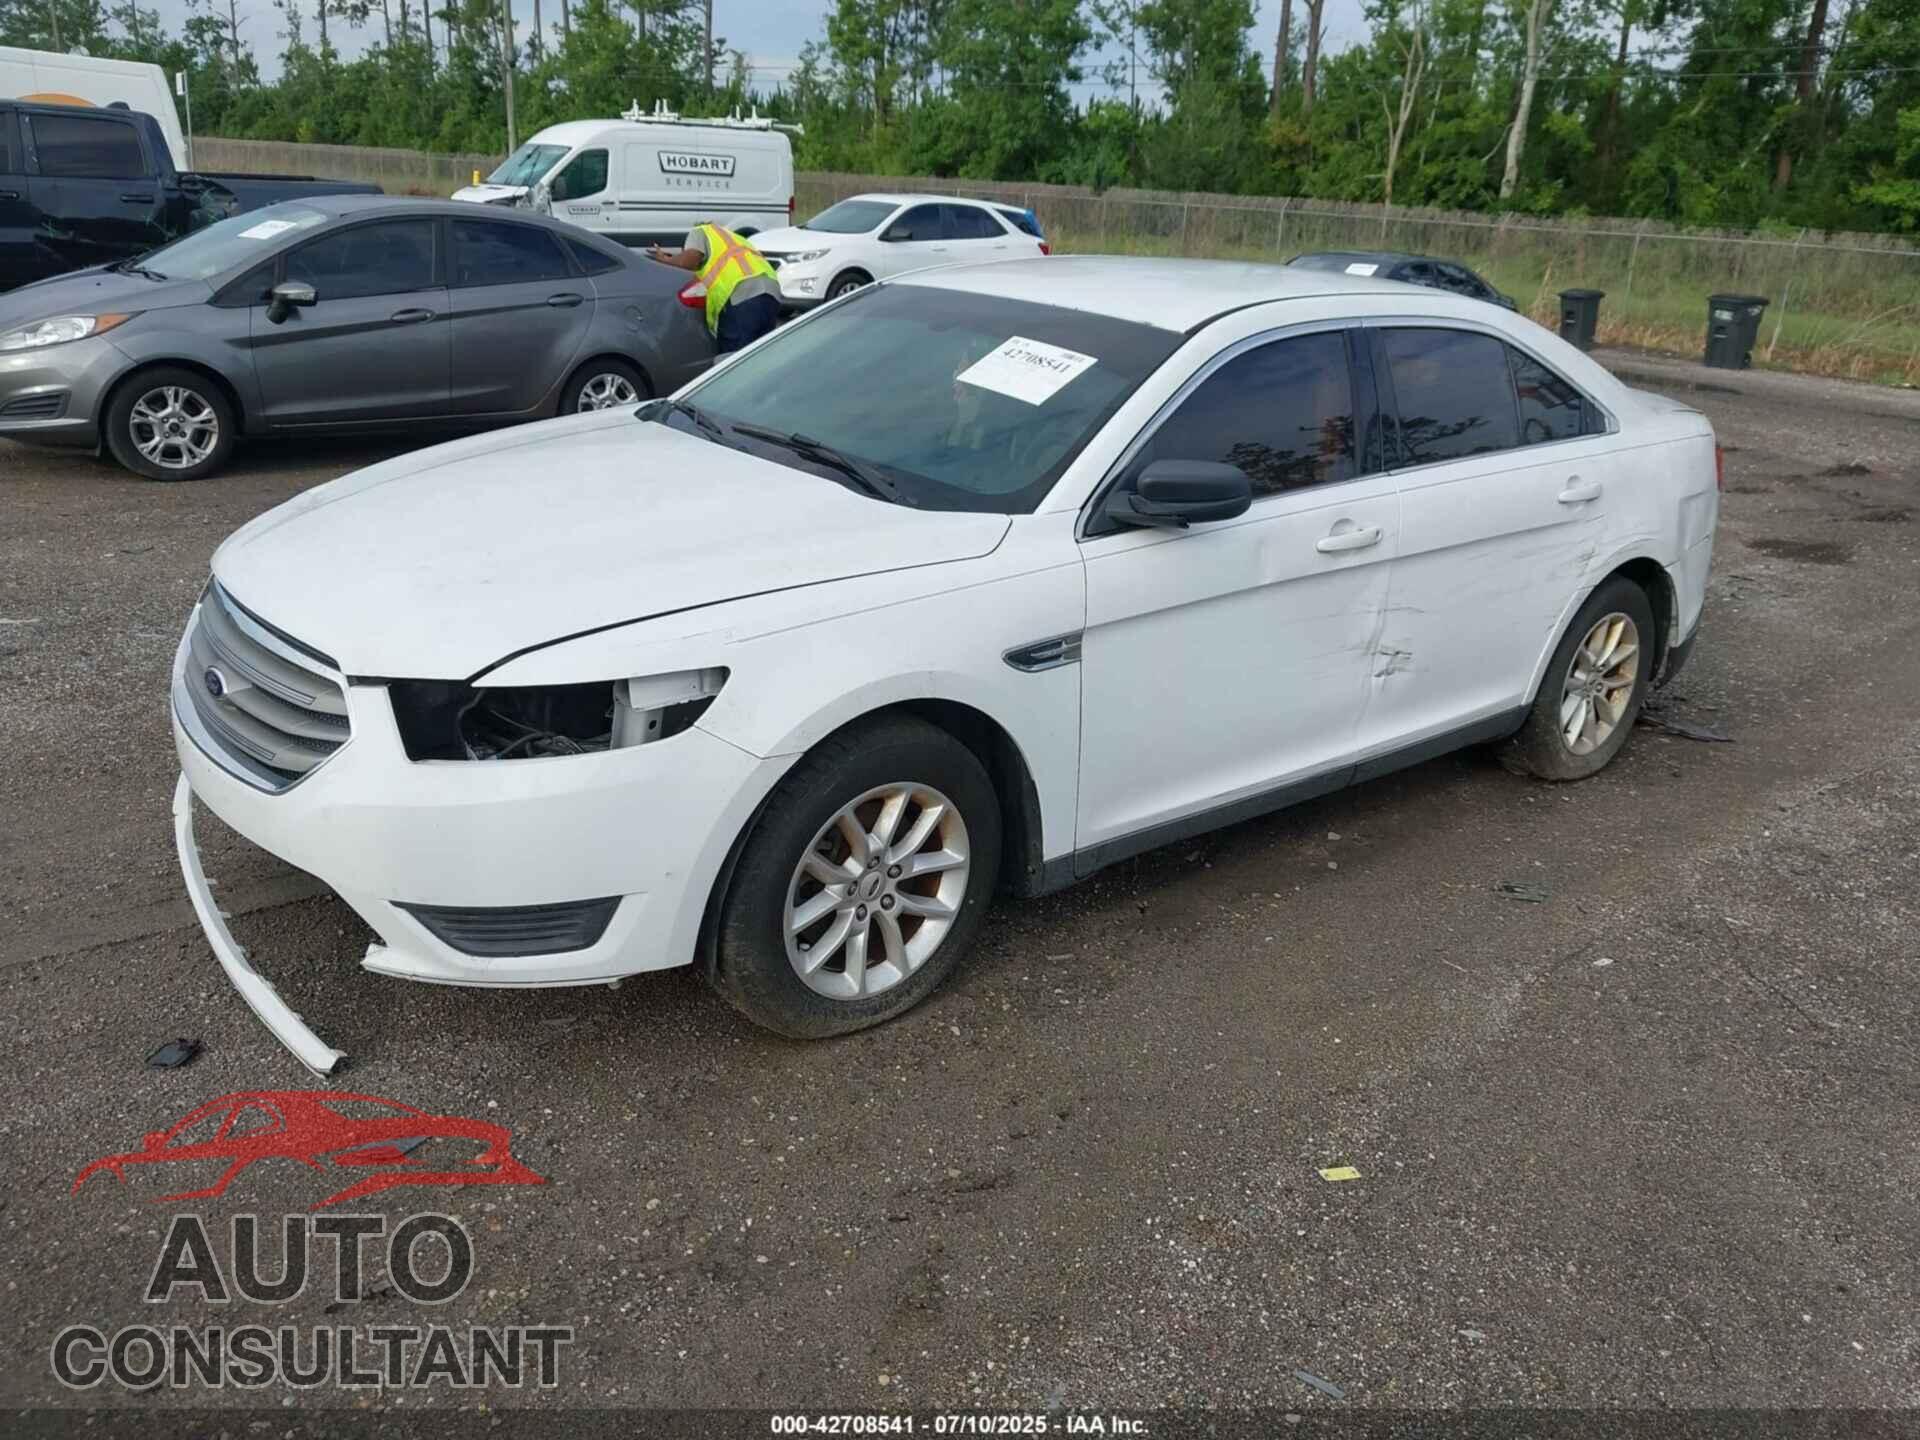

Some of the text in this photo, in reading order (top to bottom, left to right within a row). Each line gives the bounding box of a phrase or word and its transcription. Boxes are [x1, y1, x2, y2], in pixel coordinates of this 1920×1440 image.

[666, 155, 729, 170] HOBART
[665, 178, 730, 189] SERVICE
[1003, 348, 1071, 373] 42708541
